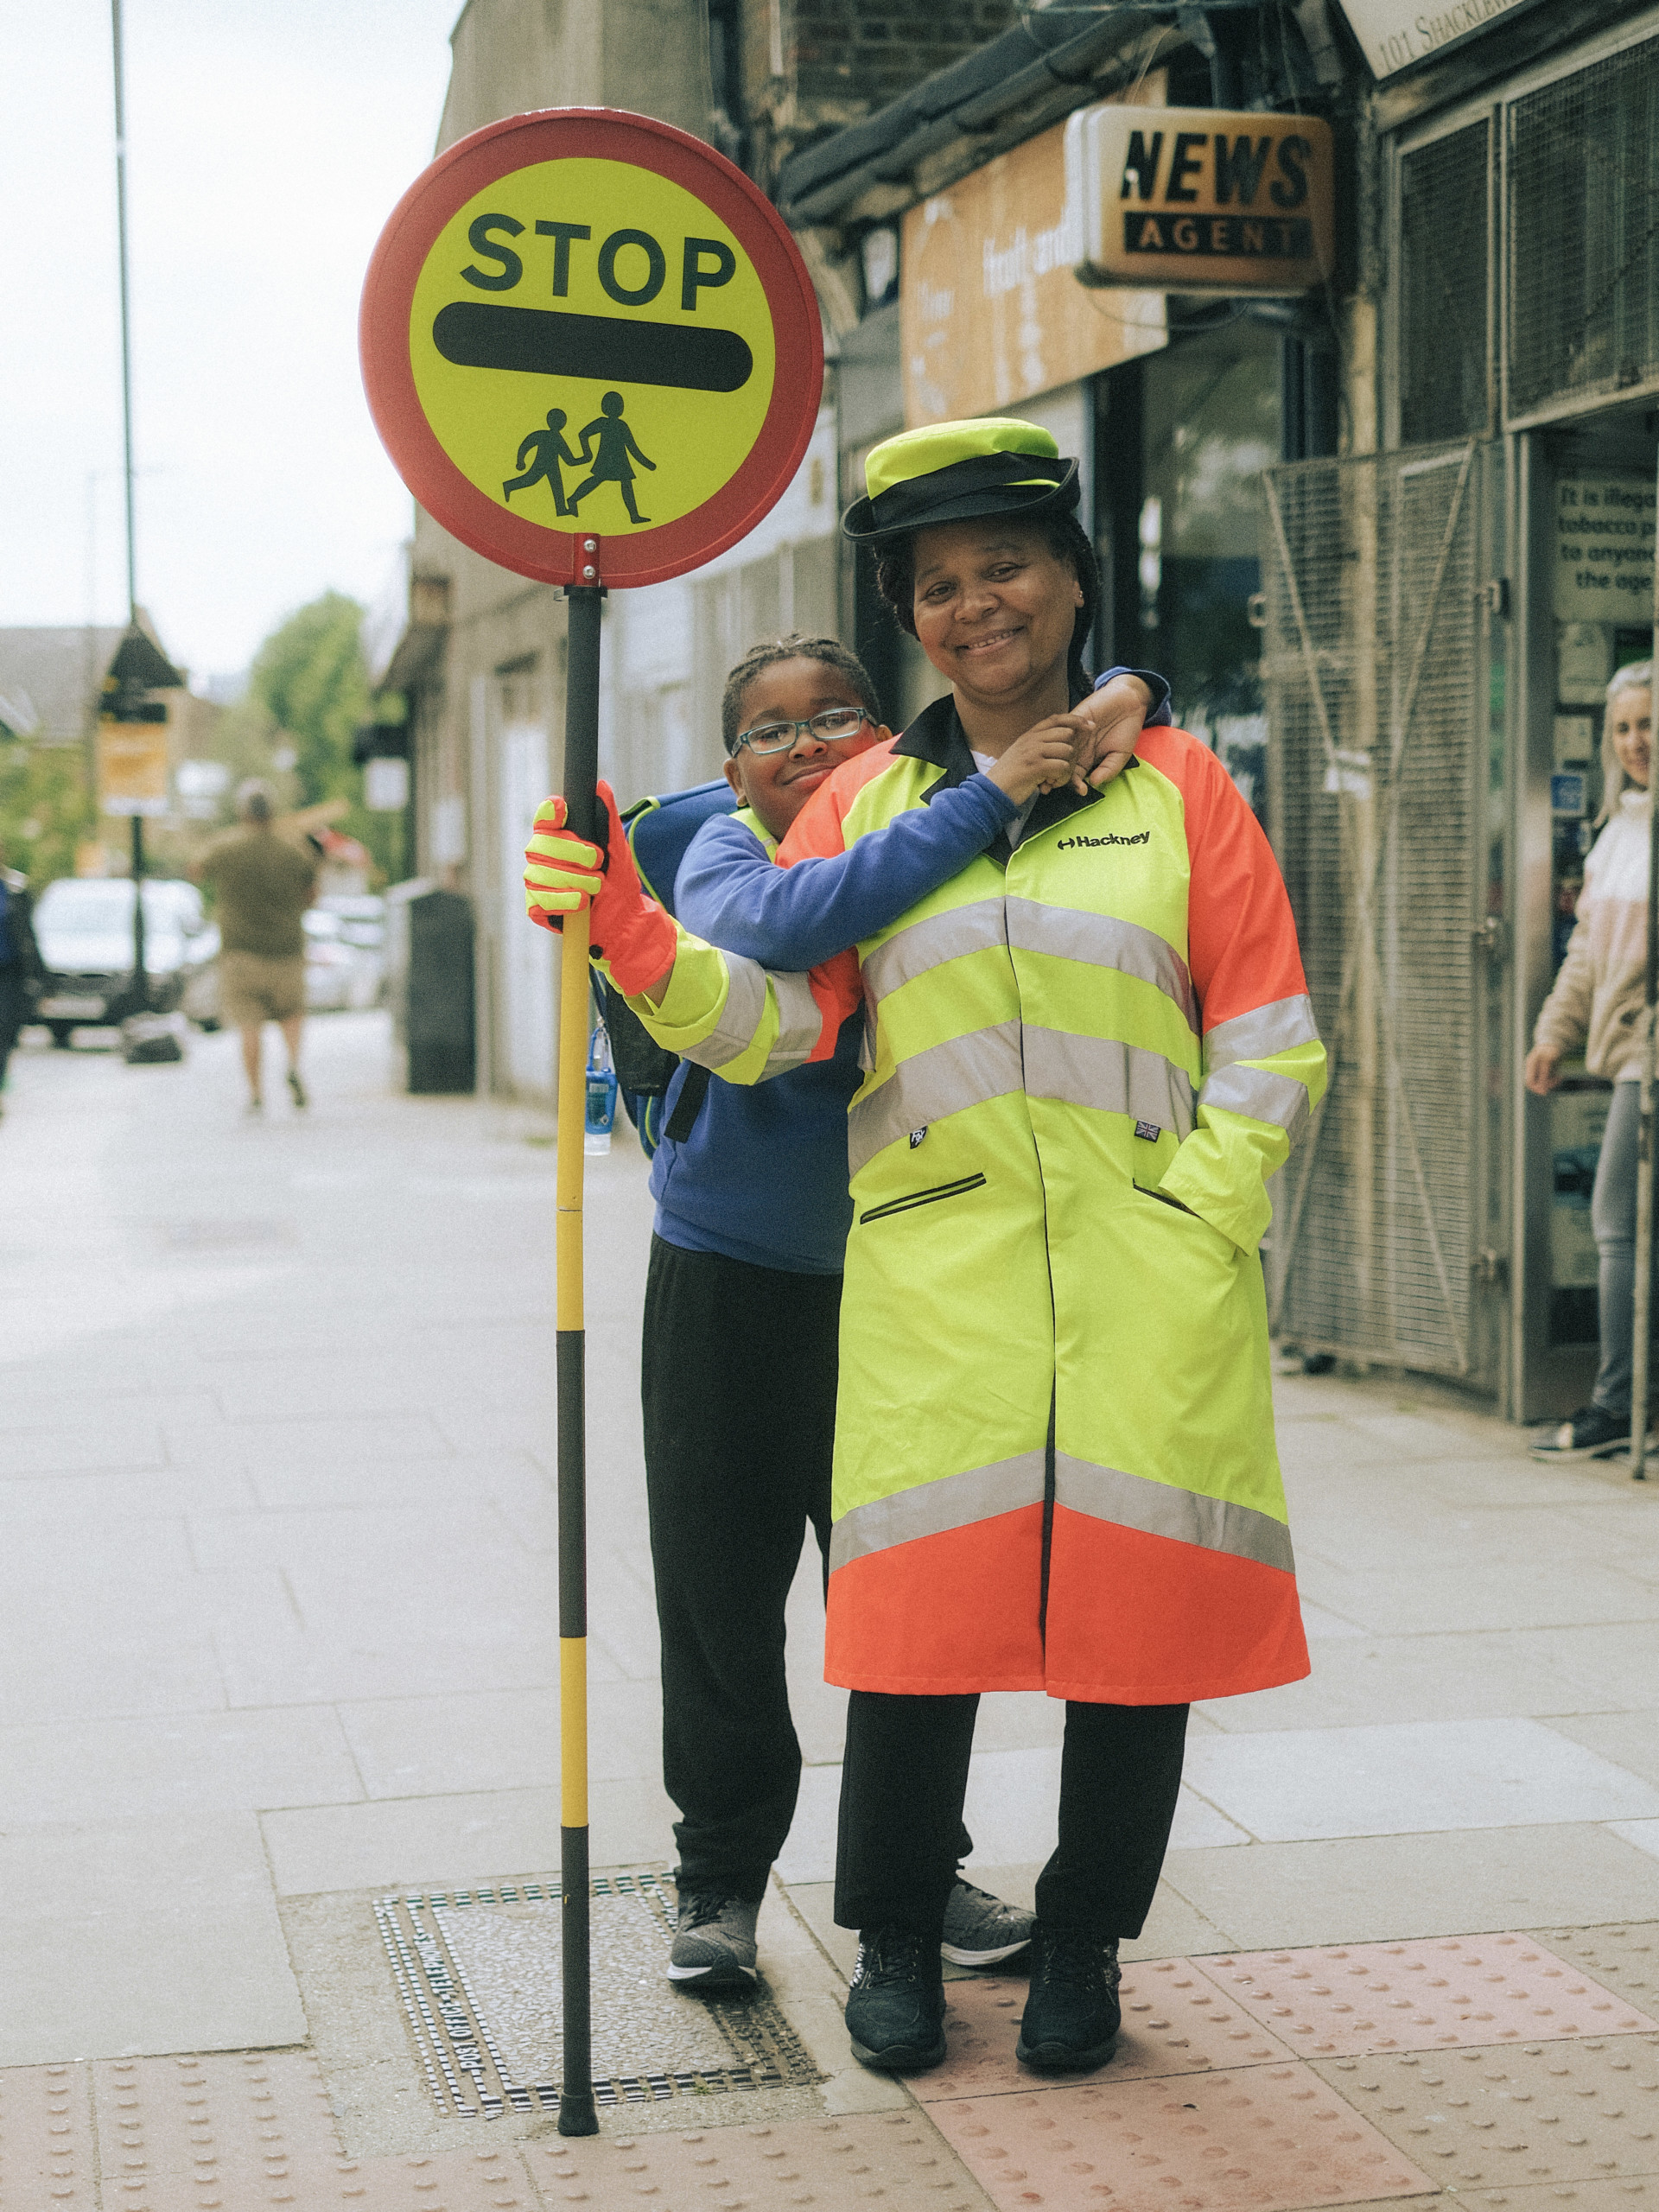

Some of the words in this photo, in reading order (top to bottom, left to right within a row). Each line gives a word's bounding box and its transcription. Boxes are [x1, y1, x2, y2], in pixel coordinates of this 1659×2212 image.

[1121, 130, 1312, 209] NEWS
[1140, 218, 1294, 251] AGENT
[460, 213, 736, 311] STOP
[1583, 487, 1599, 506] is
[1558, 514, 1637, 535] tobacco
[1560, 543, 1583, 562] to
[1576, 569, 1609, 589] the
[1615, 574, 1651, 595] age
[1076, 831, 1150, 848] Hackney
[413, 1934, 454, 1994] TELEPHONES
[438, 2000, 474, 2040] OFFICE
[453, 2040, 485, 2073] POST
